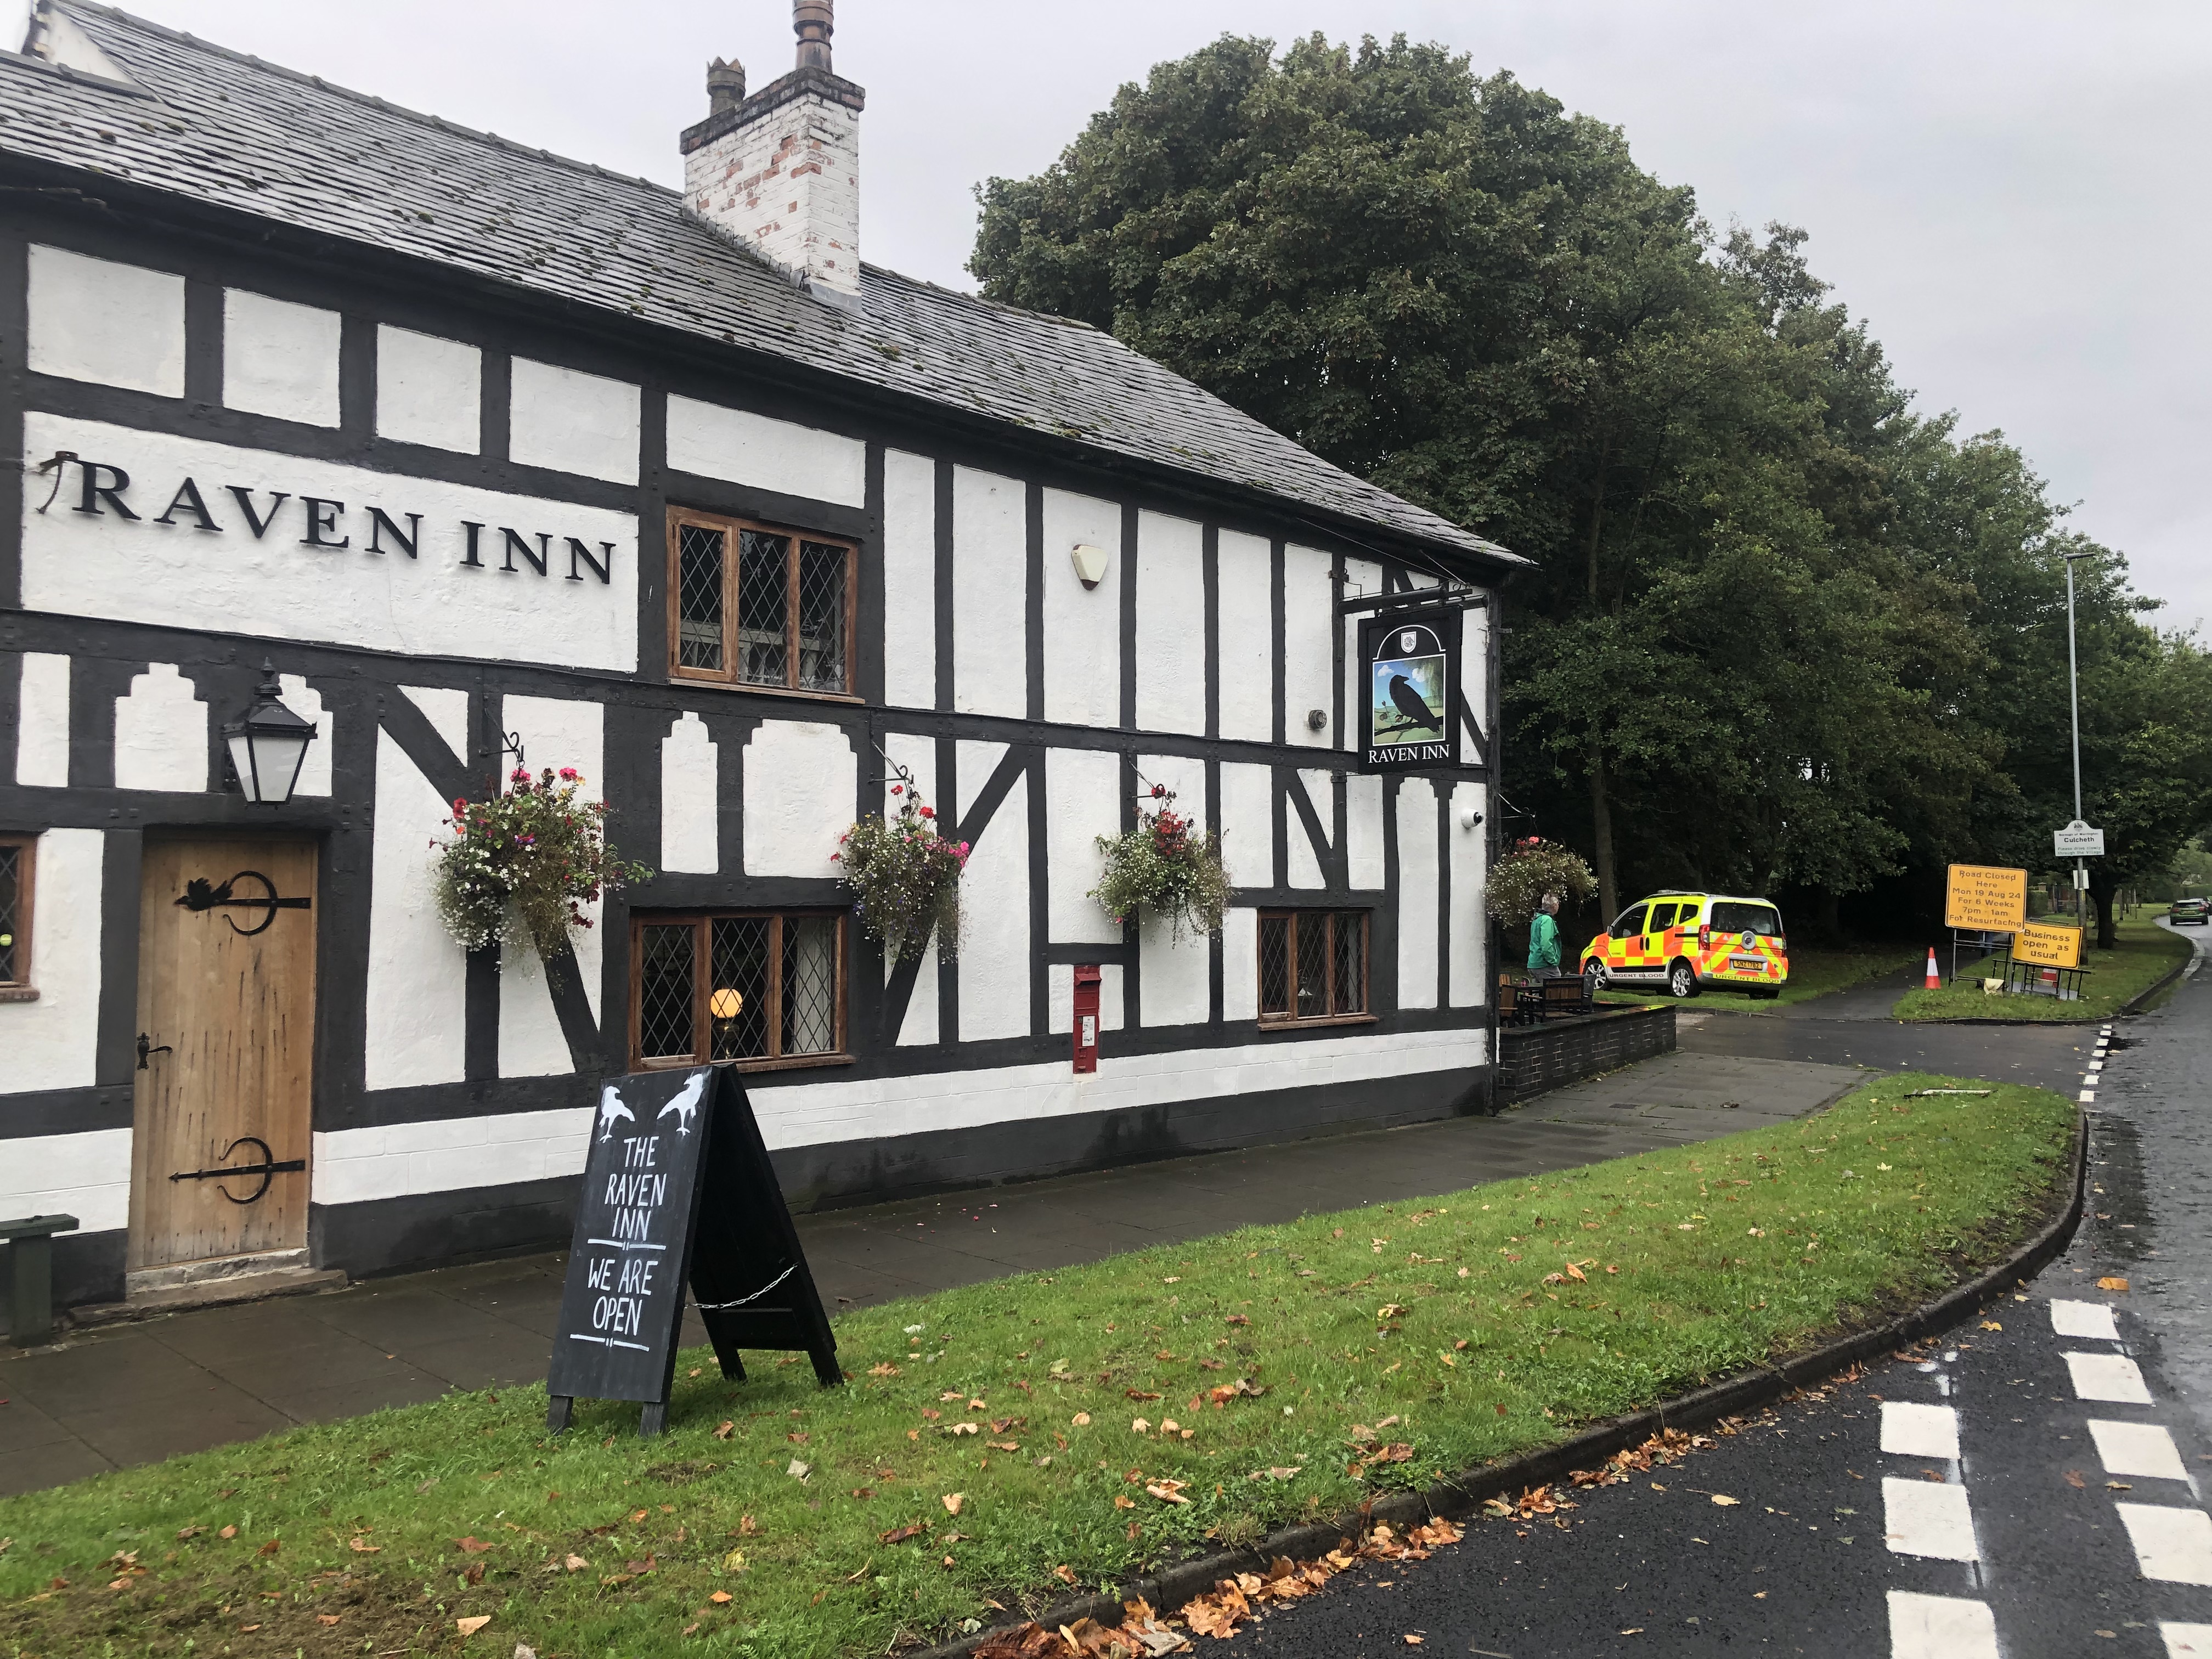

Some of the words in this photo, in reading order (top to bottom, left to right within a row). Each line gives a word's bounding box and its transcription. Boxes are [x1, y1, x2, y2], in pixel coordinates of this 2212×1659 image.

[70, 460, 425, 560] RAVEN
[459, 520, 617, 585] INN
[1368, 746, 1419, 764] RAVEN
[1422, 744, 1451, 760] INN
[1959, 870, 1982, 878] Road
[1985, 872, 2016, 882] Closed
[1953, 887, 1971, 895] Mon
[1988, 890, 2005, 899] Aug
[1985, 899, 2015, 908] Weeks
[1967, 916, 2022, 928] Resurfacing
[2023, 929, 2070, 942] Business
[2023, 940, 2048, 949] open
[2030, 950, 2058, 960] usual
[624, 1136, 660, 1168] THE
[604, 1173, 667, 1207] RAVEN
[612, 1206, 651, 1242] INN
[588, 1258, 616, 1291] WE
[618, 1260, 658, 1296] ARE
[593, 1296, 642, 1336] OPEN
